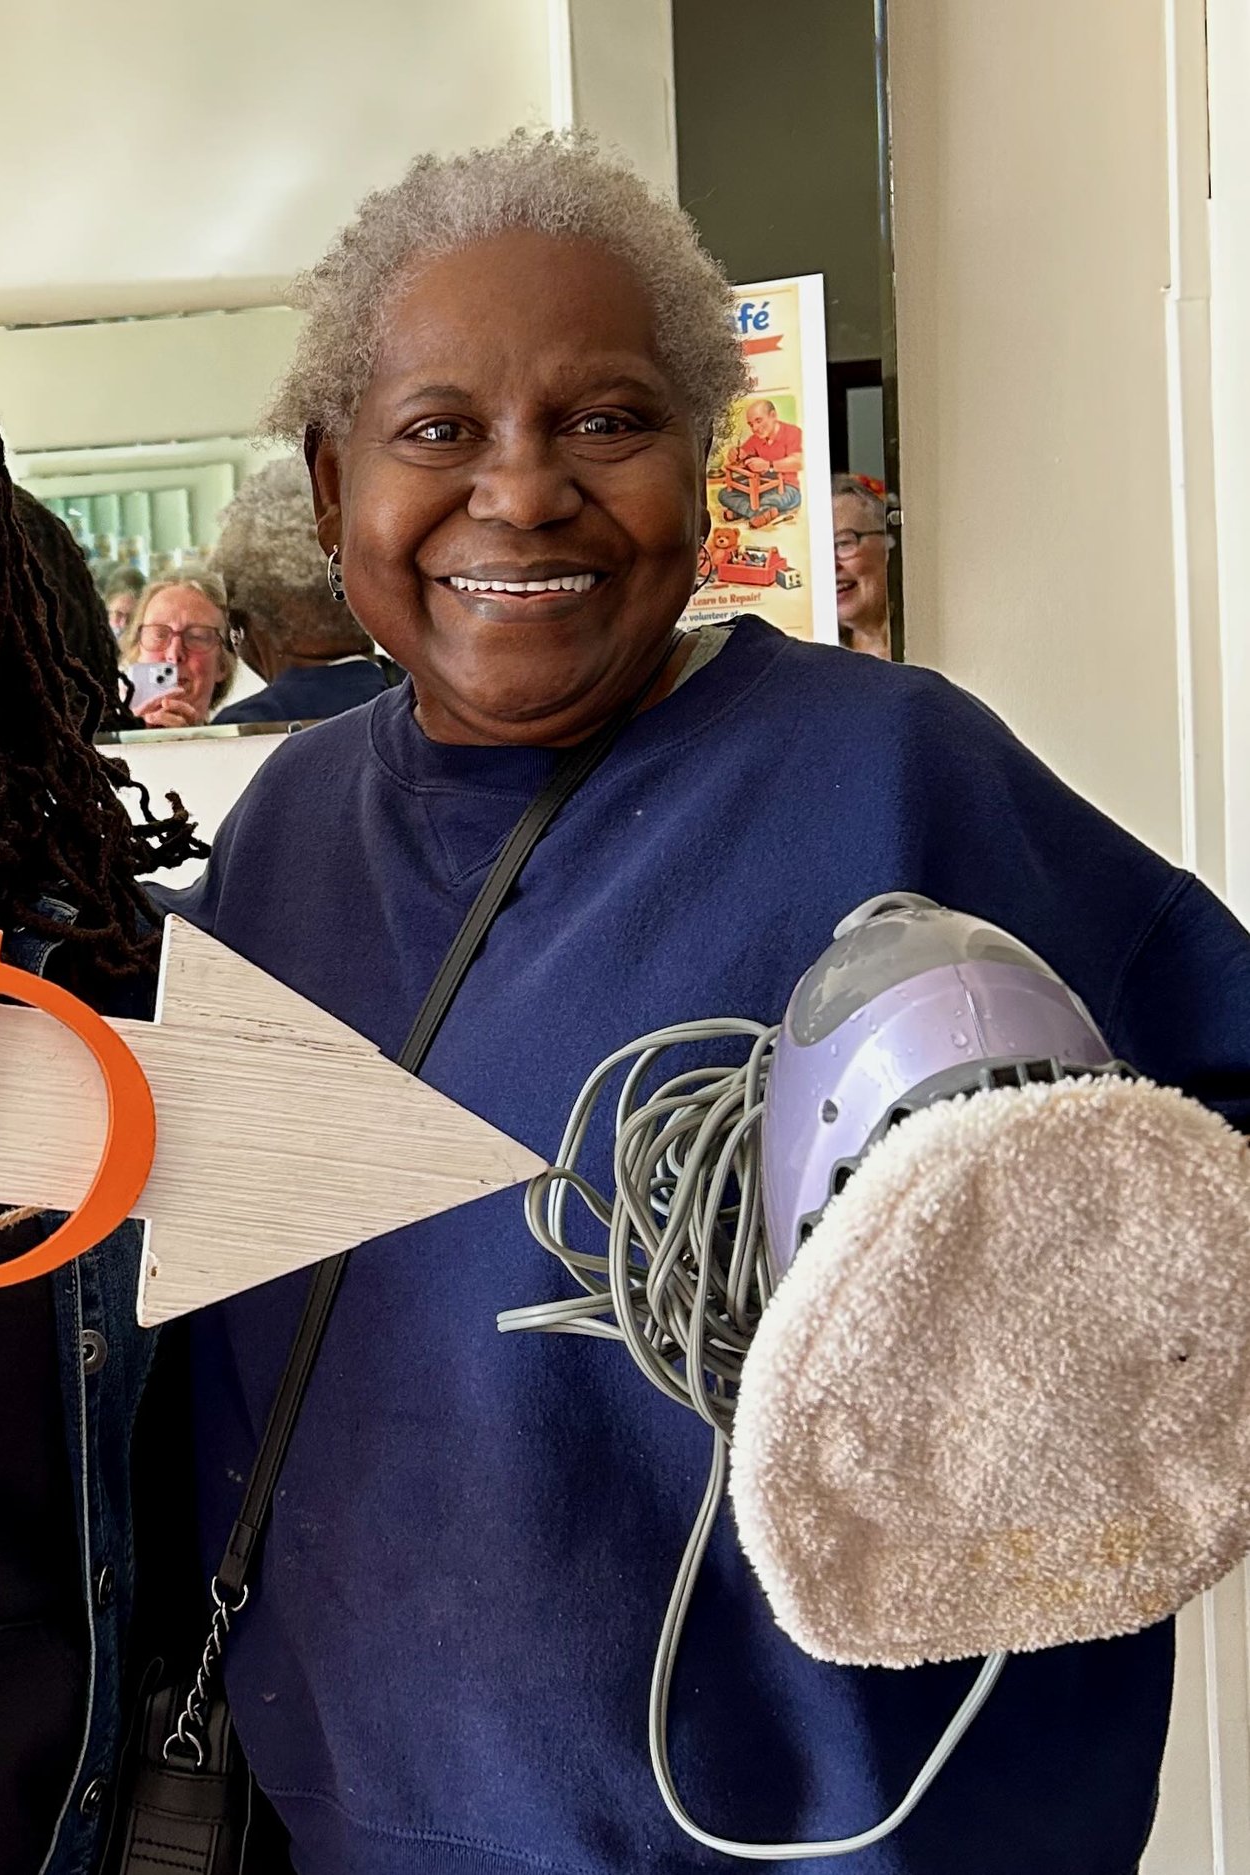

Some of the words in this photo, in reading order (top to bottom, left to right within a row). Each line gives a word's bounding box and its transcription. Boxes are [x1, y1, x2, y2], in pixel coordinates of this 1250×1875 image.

[692, 597, 716, 606] Learn
[718, 596, 728, 604] to
[730, 592, 761, 606] Repair!
[689, 611, 728, 621] volunteer
